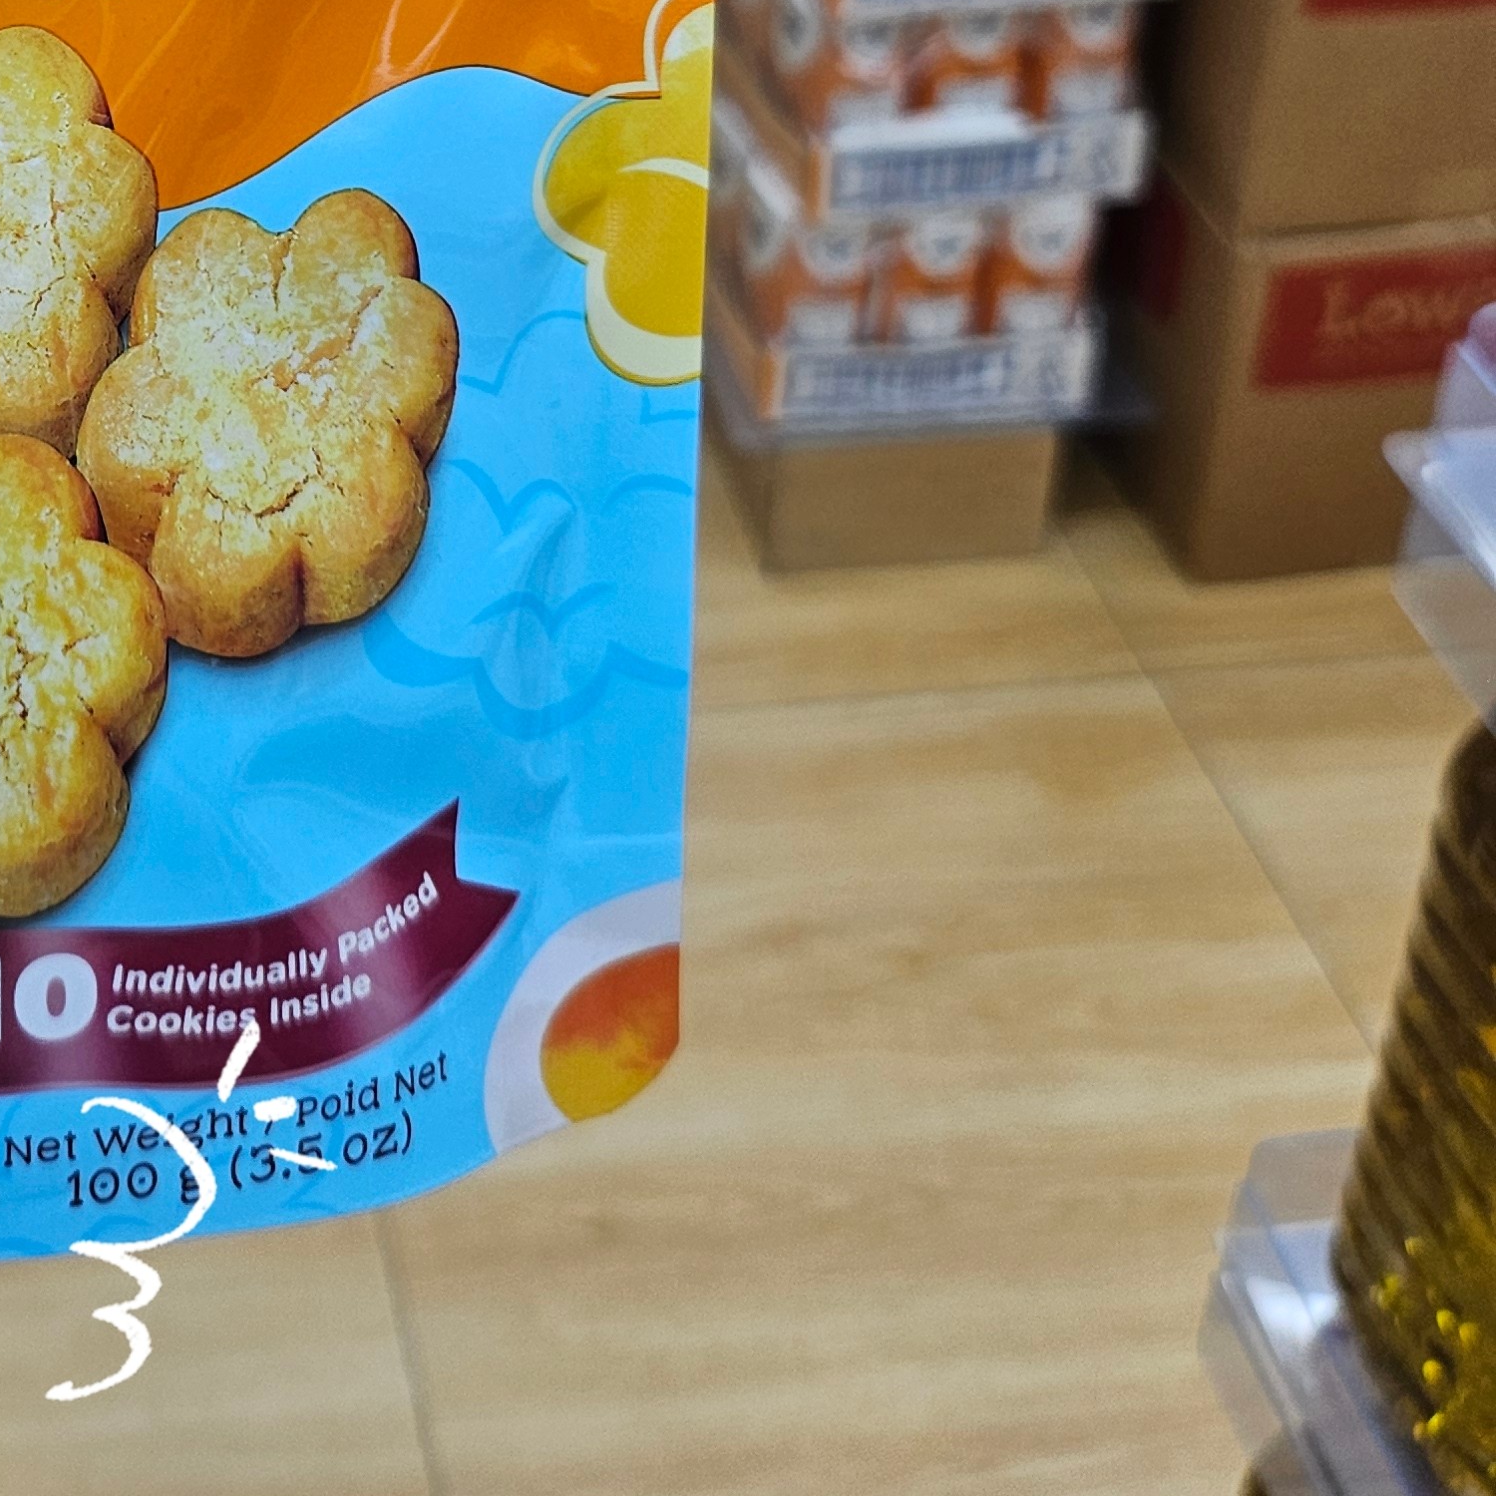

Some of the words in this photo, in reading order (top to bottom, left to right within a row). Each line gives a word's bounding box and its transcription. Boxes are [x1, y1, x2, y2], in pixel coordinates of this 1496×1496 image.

[111, 948, 328, 995] Individually
[337, 870, 440, 964] Packed
[106, 1004, 257, 1036] Cookies
[269, 972, 372, 1025] Inside
[4, 1129, 78, 1168] Net
[295, 1080, 379, 1127] Poid
[393, 1050, 449, 1102] Net
[66, 1162, 158, 1208] 100
[230, 1131, 324, 1190] (3.5
[342, 1109, 414, 1166] oz)
